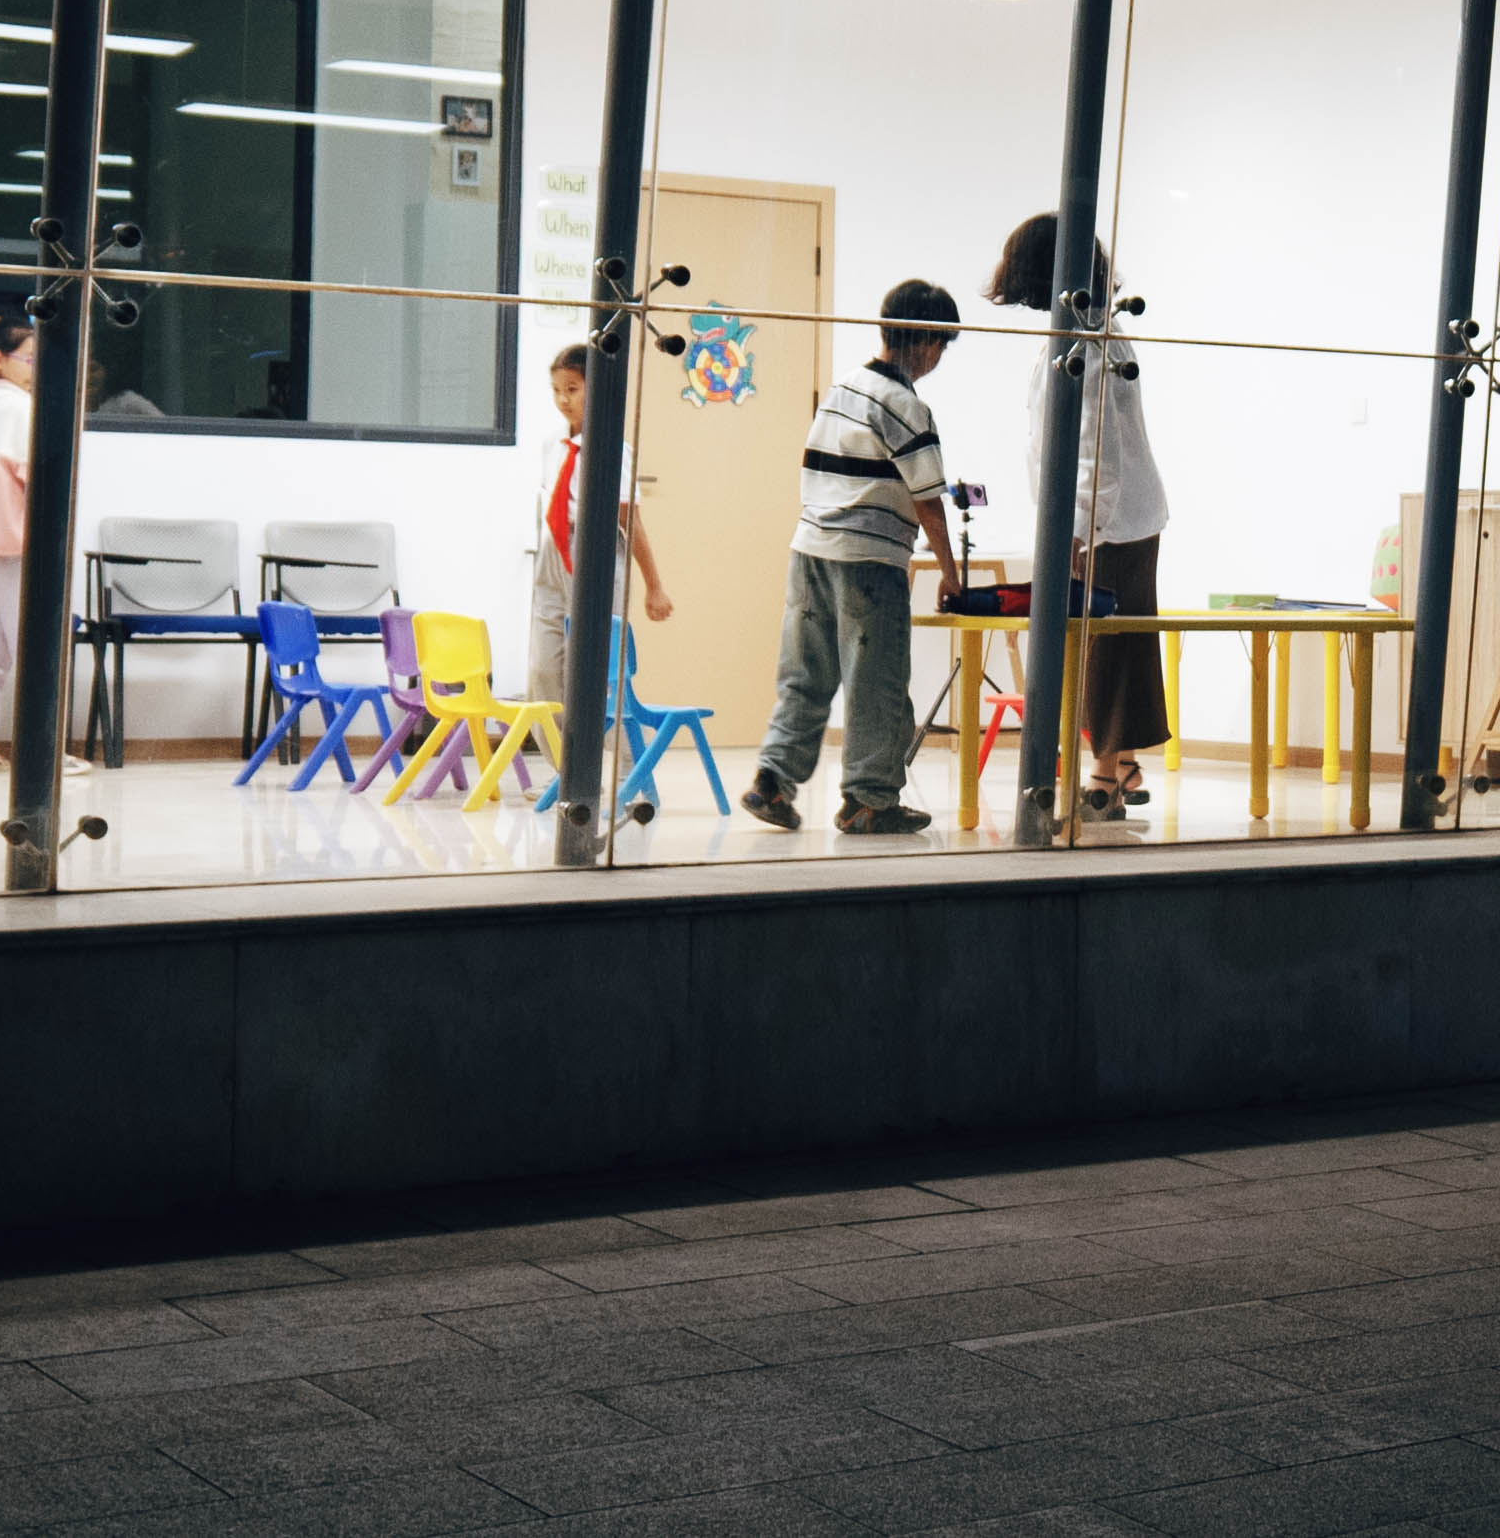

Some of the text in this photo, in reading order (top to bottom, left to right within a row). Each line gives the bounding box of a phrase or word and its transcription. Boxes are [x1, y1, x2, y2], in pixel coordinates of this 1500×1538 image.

[546, 171, 587, 194] What
[544, 212, 590, 239] When
[534, 252, 587, 278] Where
